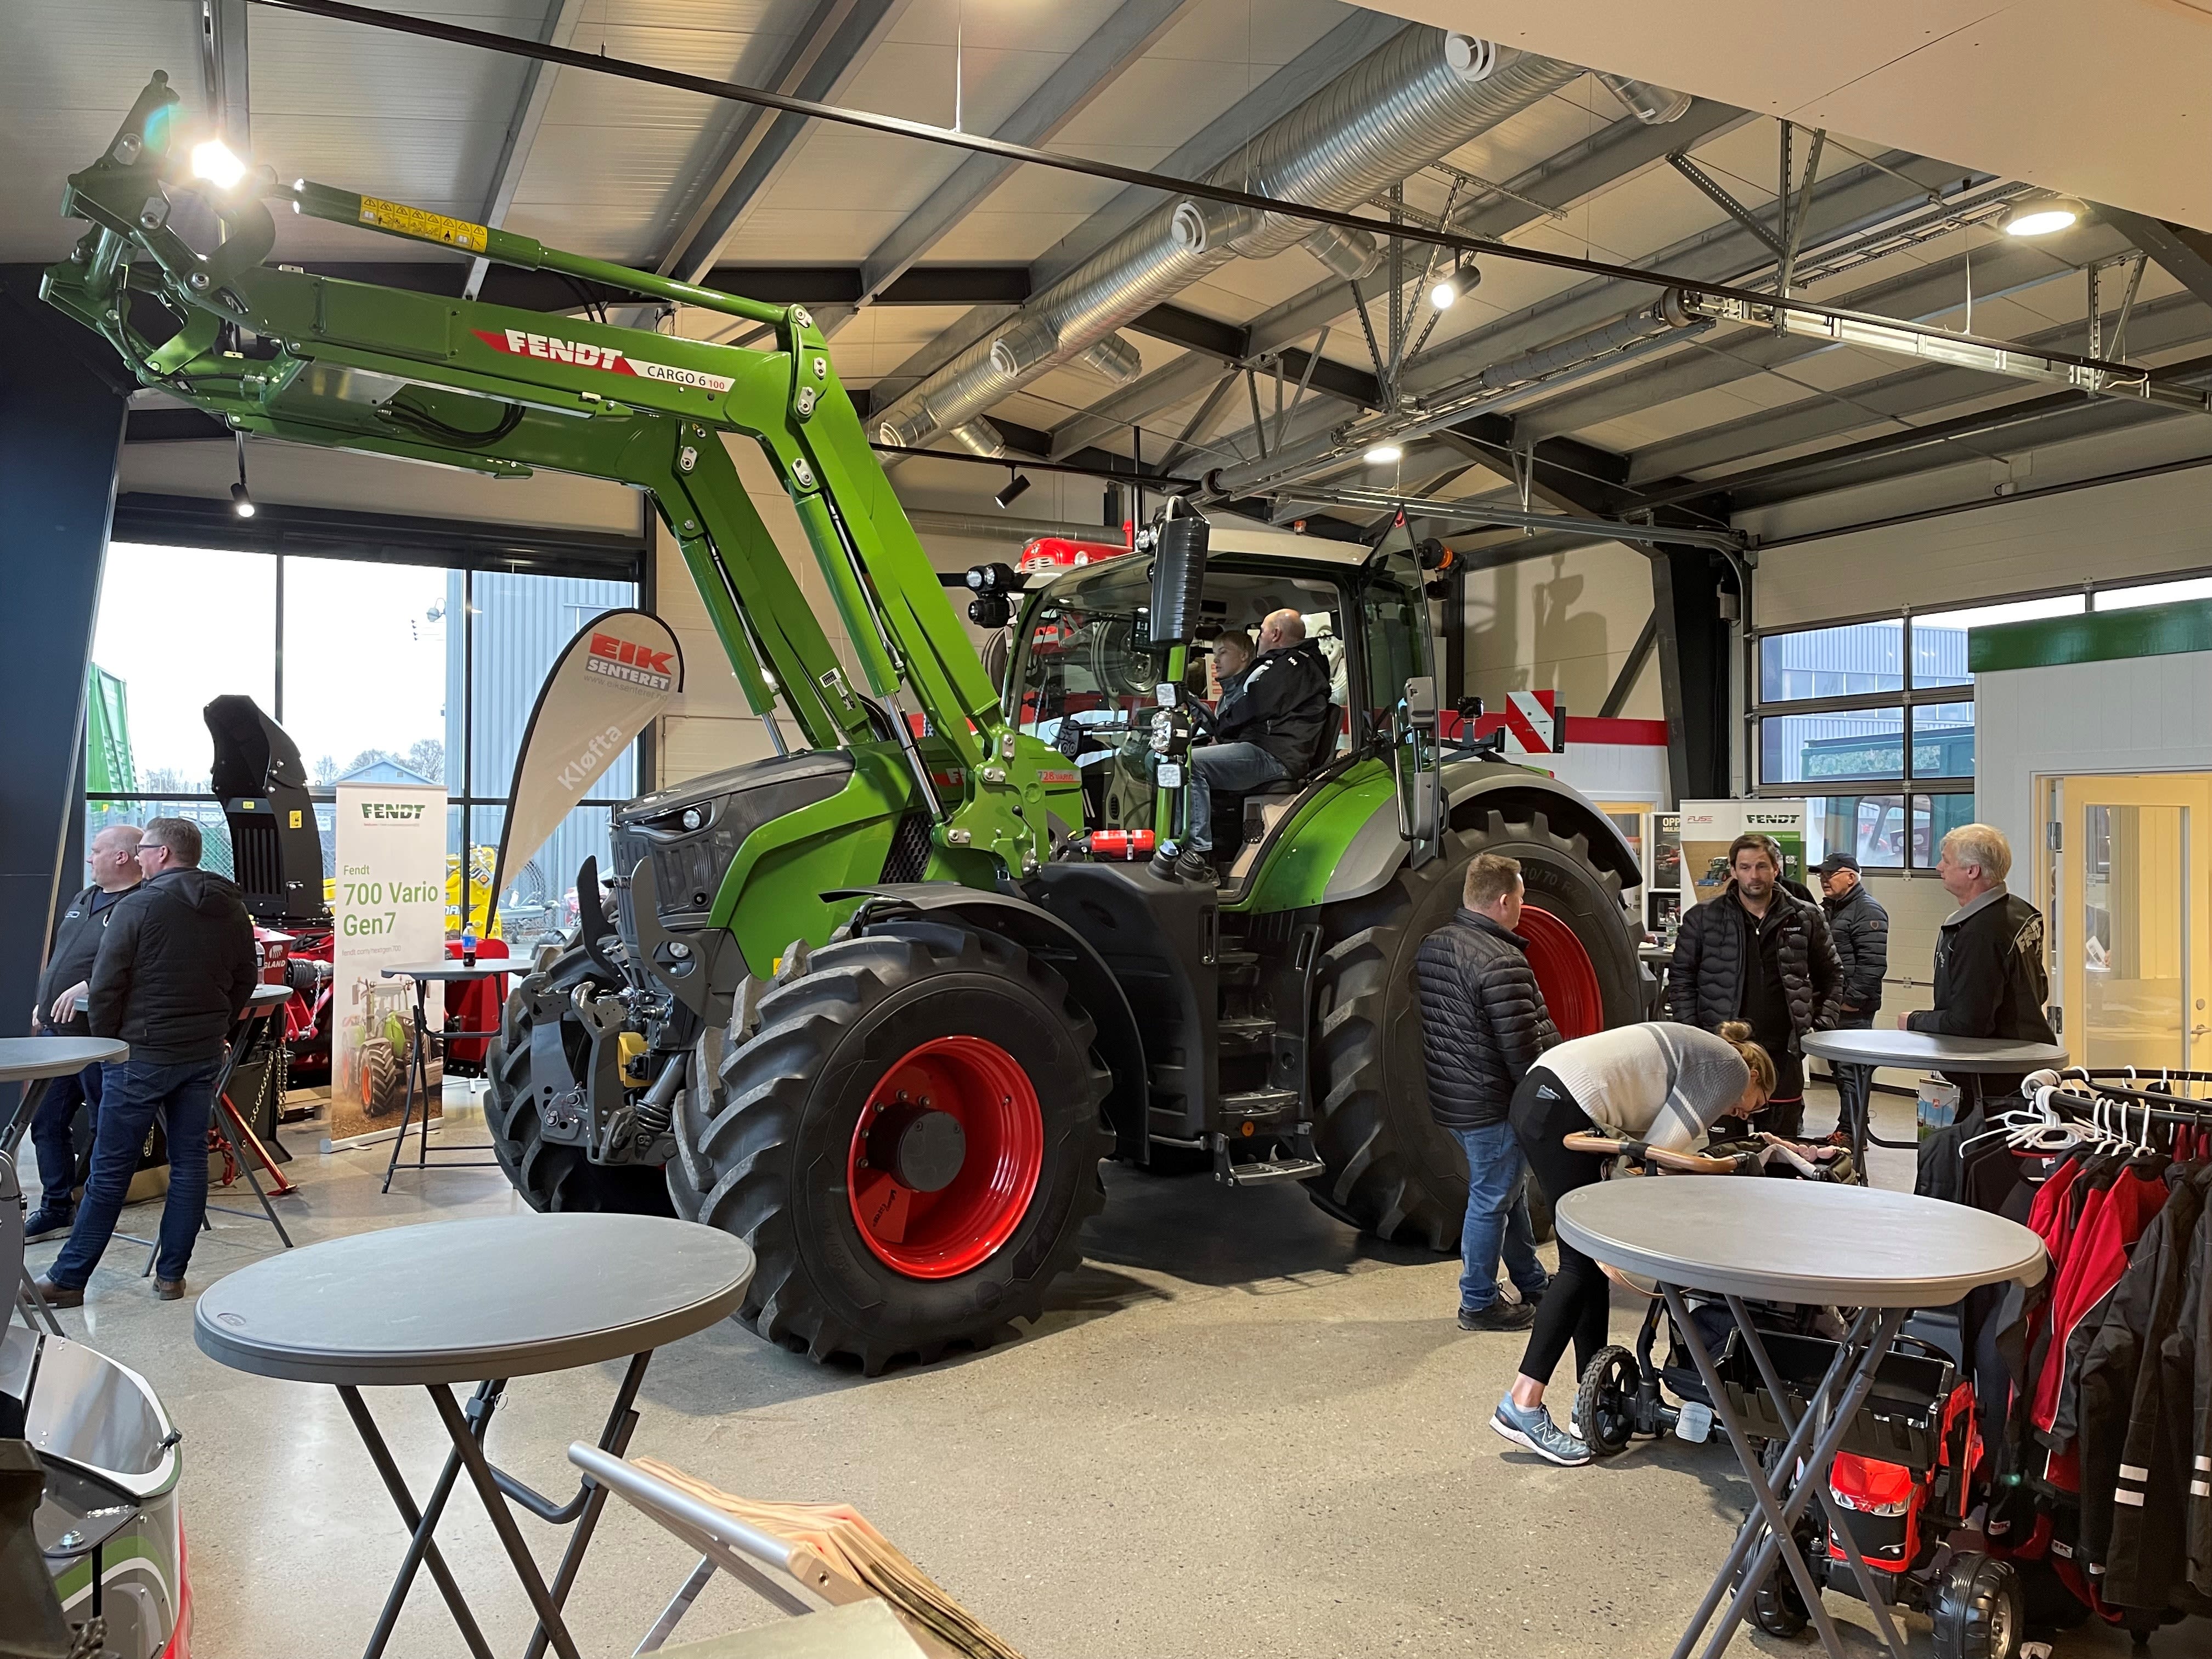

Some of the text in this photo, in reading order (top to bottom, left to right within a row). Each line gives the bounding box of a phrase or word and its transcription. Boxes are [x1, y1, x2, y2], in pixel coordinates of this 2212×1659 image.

[505, 329, 623, 370] FENDT
[647, 365, 725, 390] CARGO 6 100
[589, 633, 675, 675] EIK
[588, 658, 669, 690] SENTERET
[584, 674, 668, 702] www.eiksenteret.no
[557, 725, 623, 791] Kløfta
[361, 803, 426, 819] FENDT
[1746, 815, 1800, 823] FENDT
[343, 865, 370, 875] Fendt
[1521, 867, 1558, 885] 10/70
[343, 881, 438, 906] 700 Vario
[343, 912, 396, 936] Gen7
